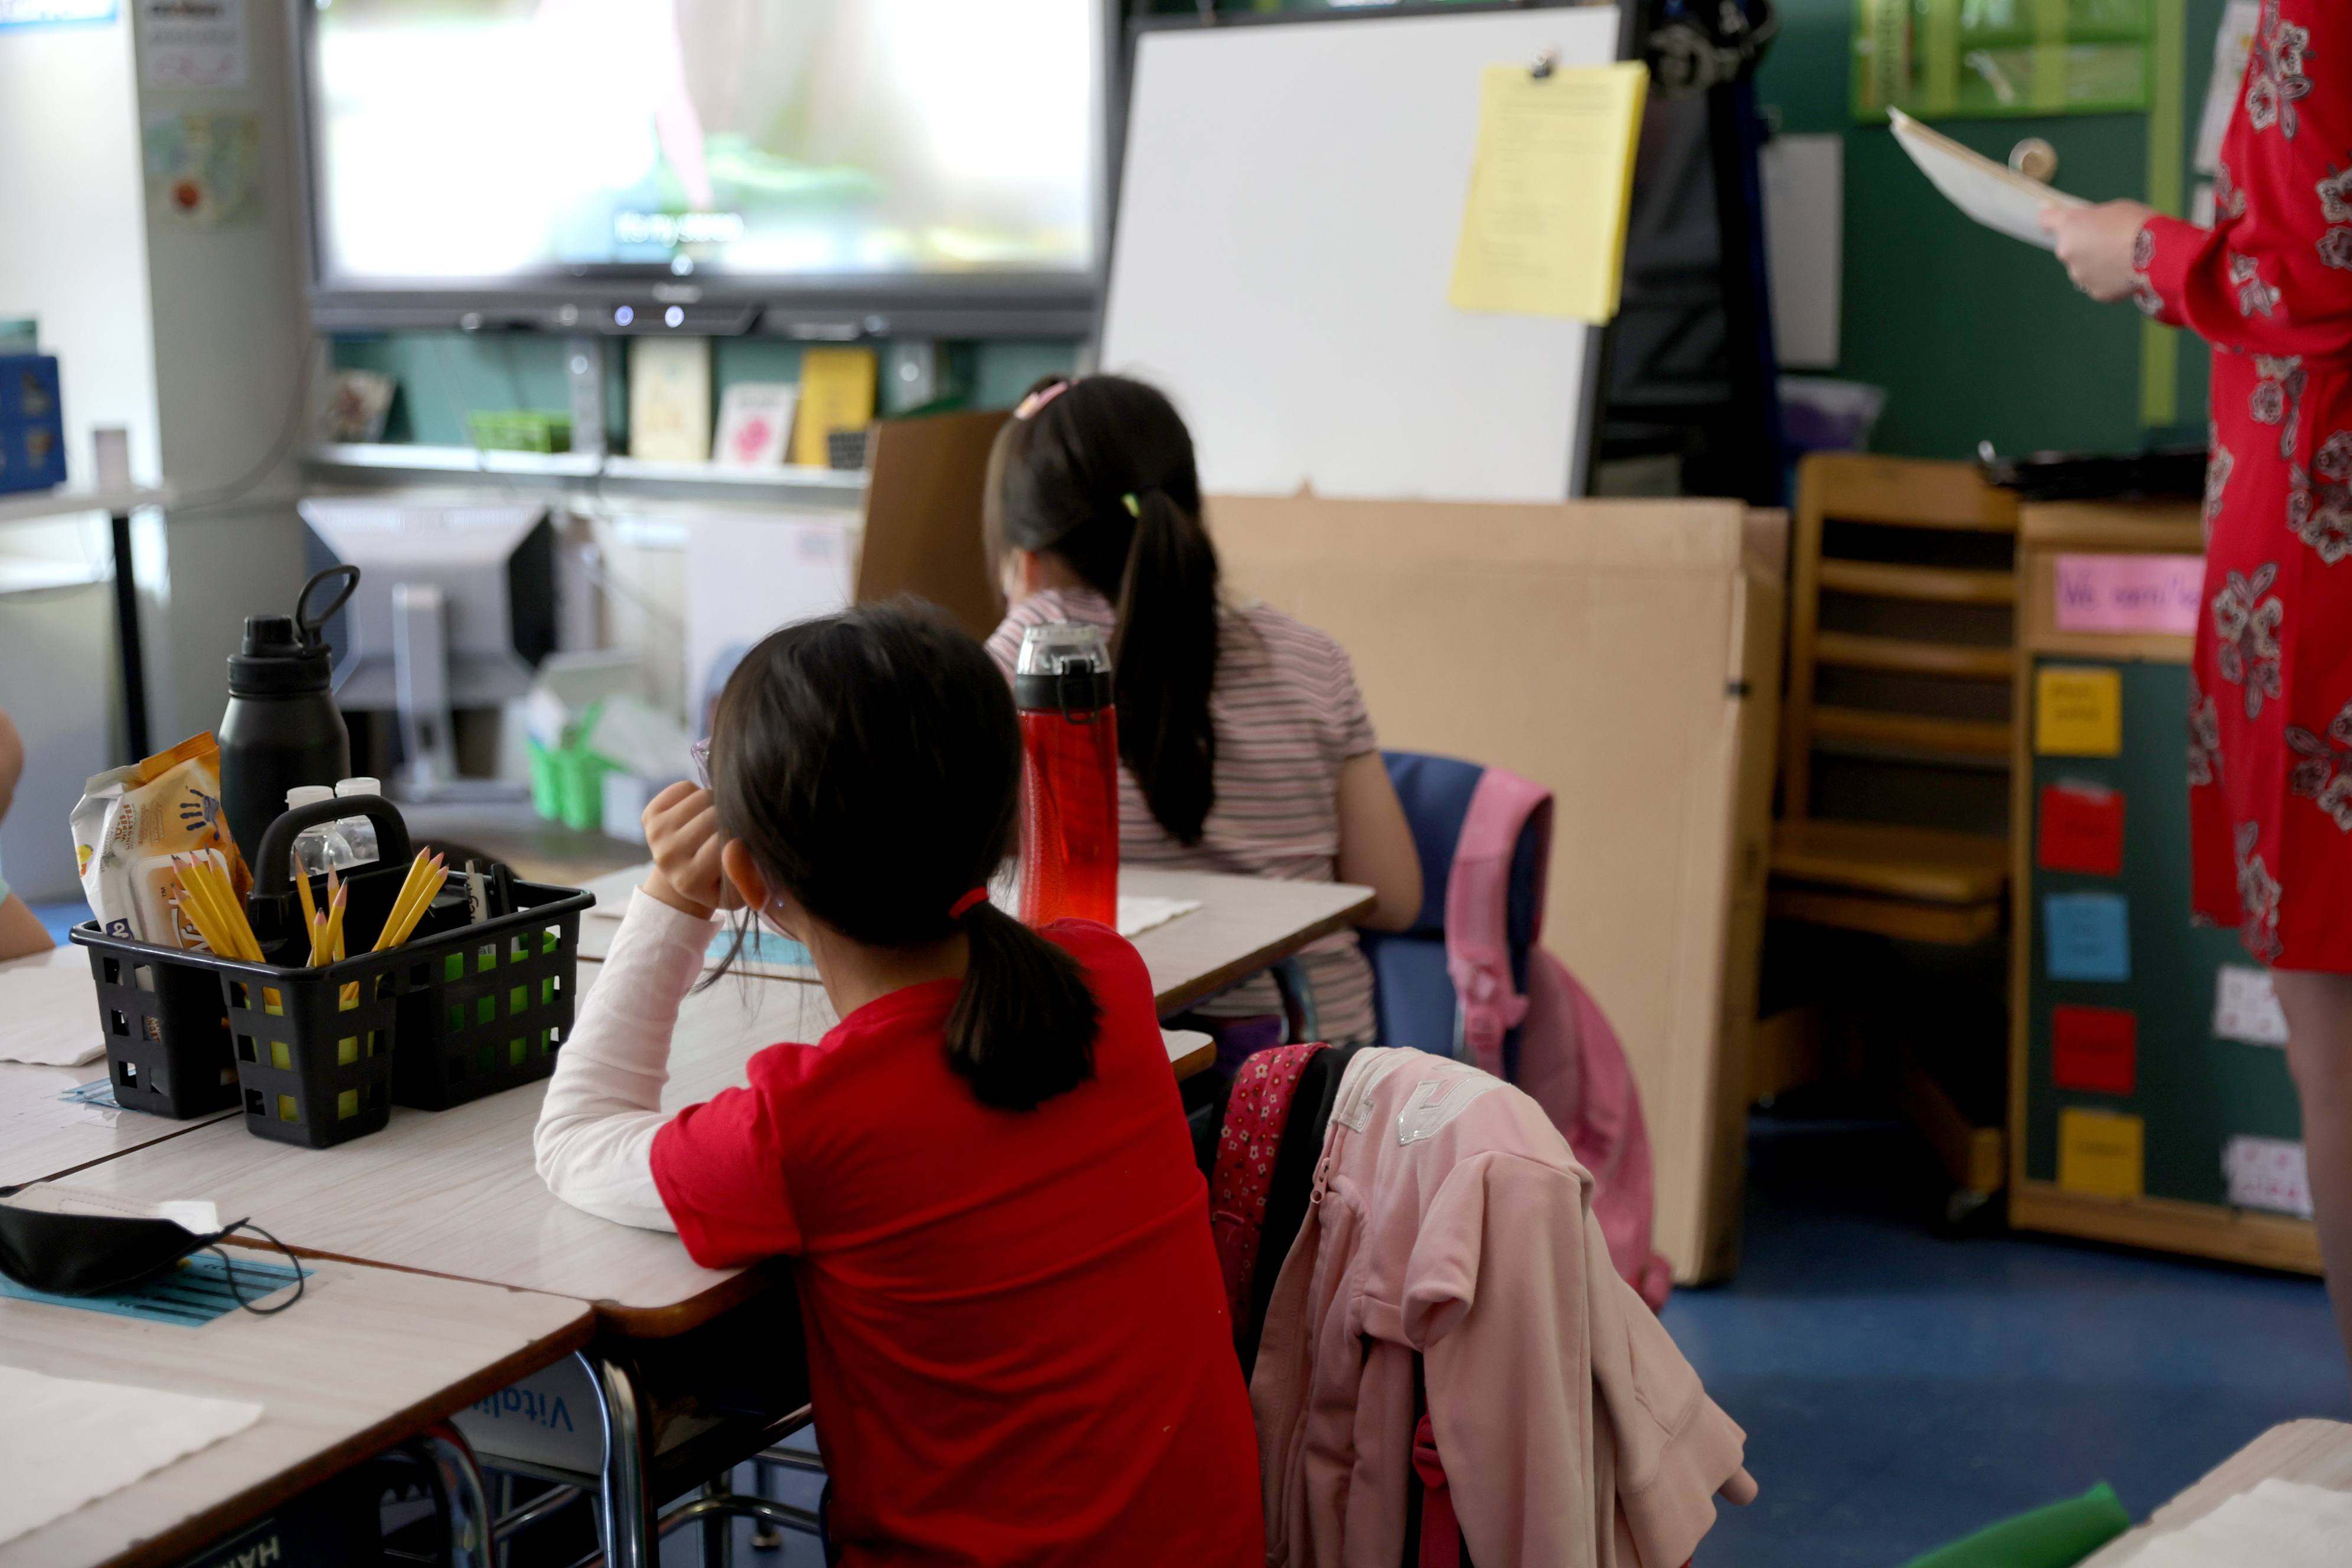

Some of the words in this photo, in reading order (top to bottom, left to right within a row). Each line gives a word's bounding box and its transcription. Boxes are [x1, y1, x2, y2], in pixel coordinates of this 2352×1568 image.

[119, 814, 128, 842] WIPES
[123, 803, 133, 850] LINGETTES
[161, 886, 167, 898] TM
[472, 1387, 574, 1433] Vitali
